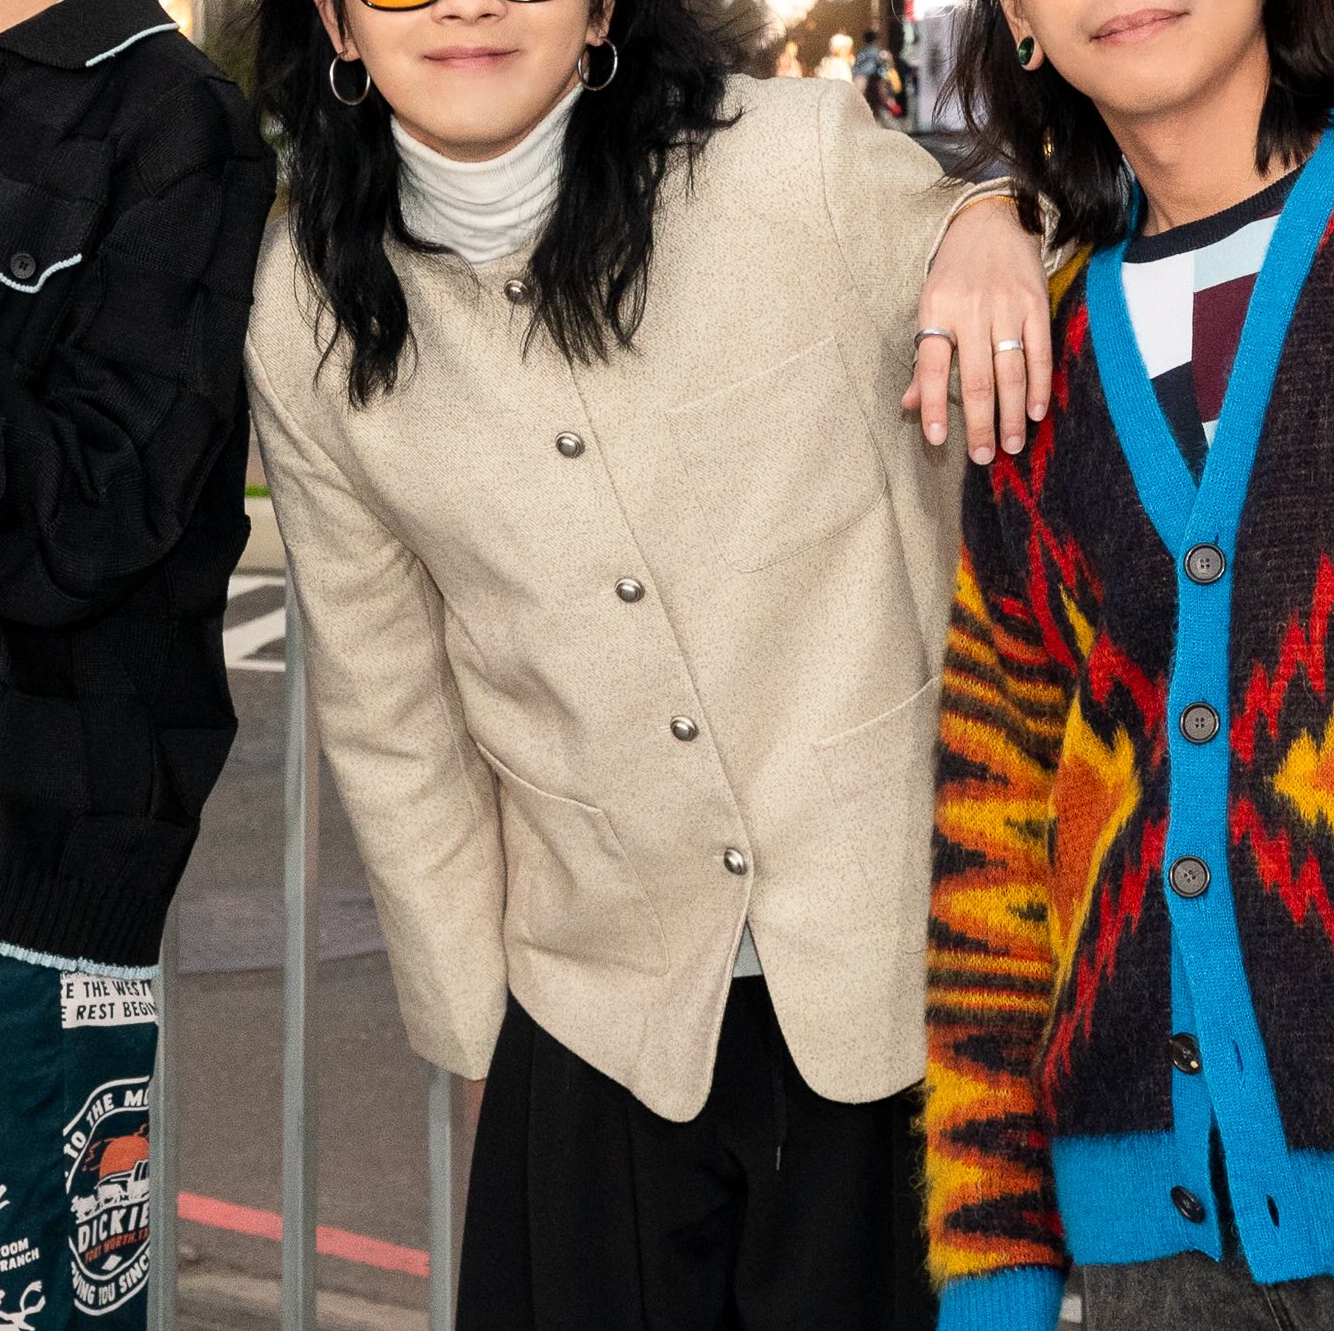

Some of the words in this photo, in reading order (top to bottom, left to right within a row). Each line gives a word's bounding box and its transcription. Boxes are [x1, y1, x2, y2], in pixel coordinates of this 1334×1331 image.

[83, 981, 110, 998] THE
[76, 1003, 115, 1021] REST
[63, 1131, 87, 1159] TO
[86, 1093, 115, 1128] THE
[0, 1247, 40, 1272] RANCH
[118, 1247, 149, 1294] SINC
